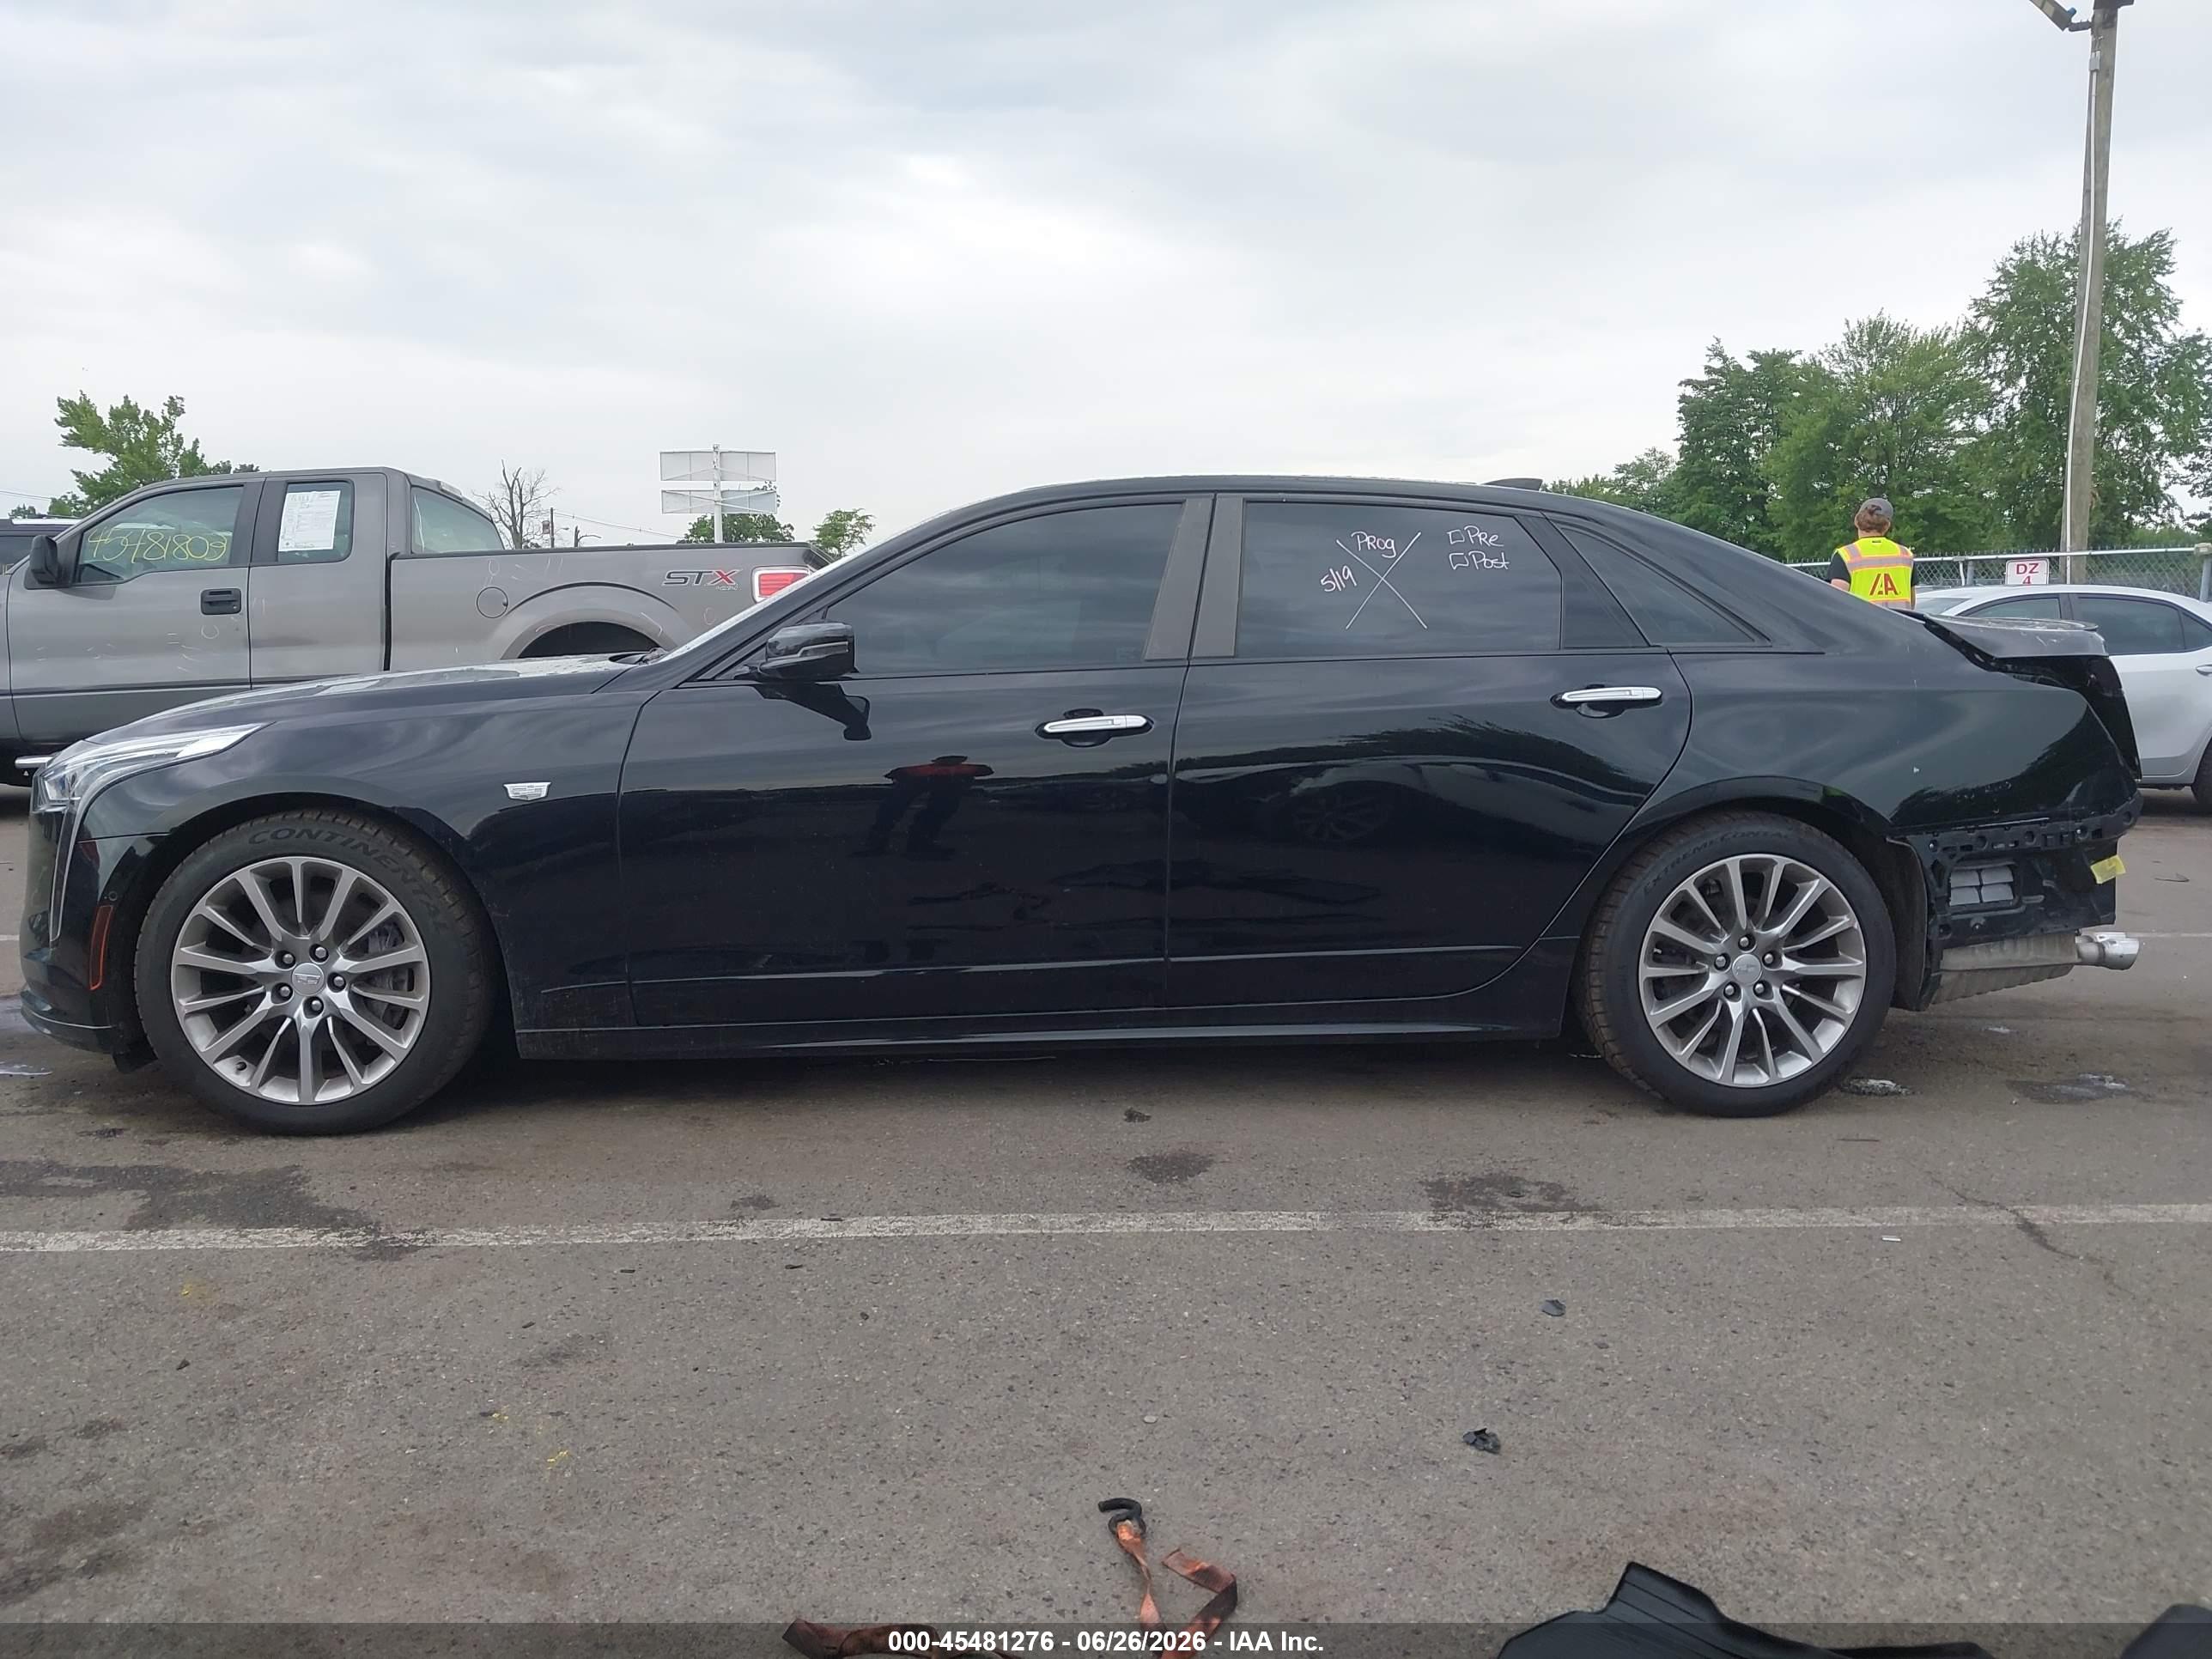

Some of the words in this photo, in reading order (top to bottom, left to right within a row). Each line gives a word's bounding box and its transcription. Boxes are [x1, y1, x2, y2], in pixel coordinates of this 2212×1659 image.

[1468, 550, 1510, 570] Post
[2015, 562, 2039, 574] DZ
[661, 568, 743, 586] STX
